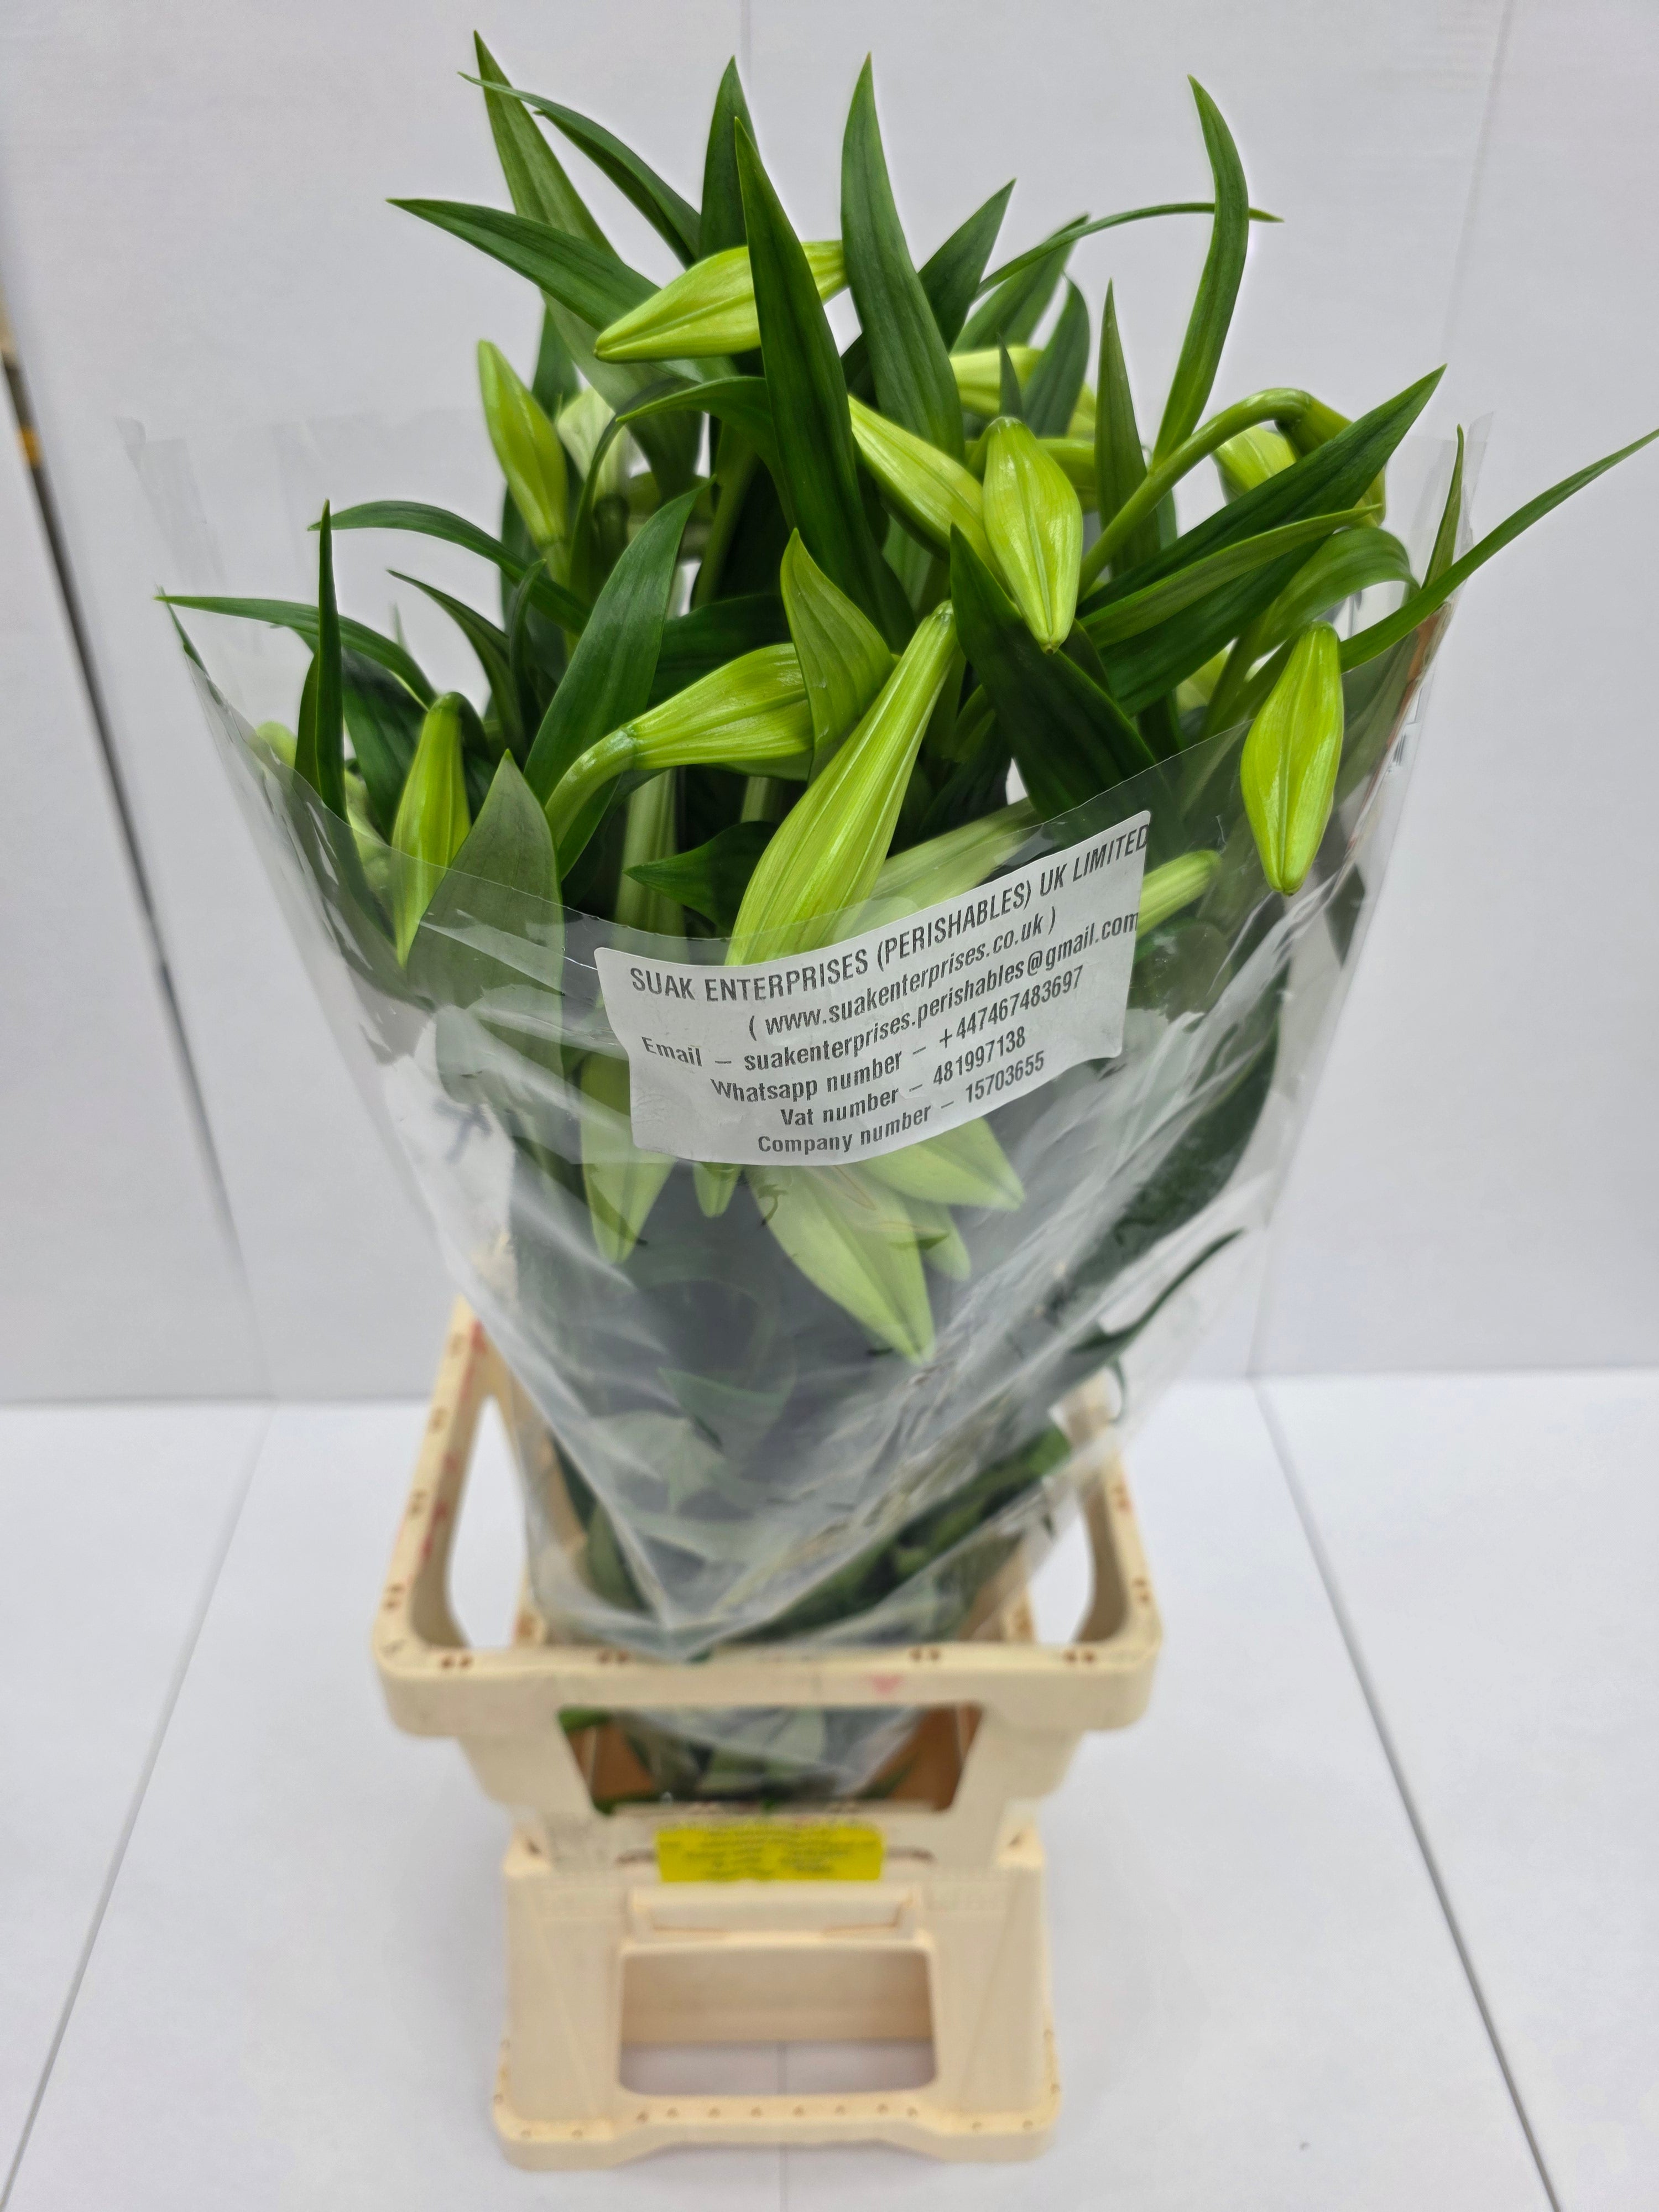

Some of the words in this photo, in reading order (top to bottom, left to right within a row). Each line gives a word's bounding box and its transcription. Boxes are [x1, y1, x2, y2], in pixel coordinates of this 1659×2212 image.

[630, 968, 695, 1000] SUAK
[705, 948, 868, 1002] ENTERPRISES
[877, 880, 1031, 972] (PERISHABLES)
[1040, 863, 1067, 897] UK
[1073, 824, 1149, 882] LIMITED
[641, 1037, 702, 1067] Email
[744, 912, 1139, 1071] suakenterprises.perishables@gmail.com
[765, 913, 1044, 1036] www.suakenterprises.co.uk
[709, 1078, 817, 1102] Whatsapp
[827, 1051, 902, 1093] number
[758, 1134, 853, 1155] Company
[860, 1105, 931, 1145] number
[965, 1050, 1045, 1103] 15703655
[780, 1108, 813, 1126] Vat
[823, 1088, 899, 1124] number
[933, 1026, 1025, 1085] 481997138
